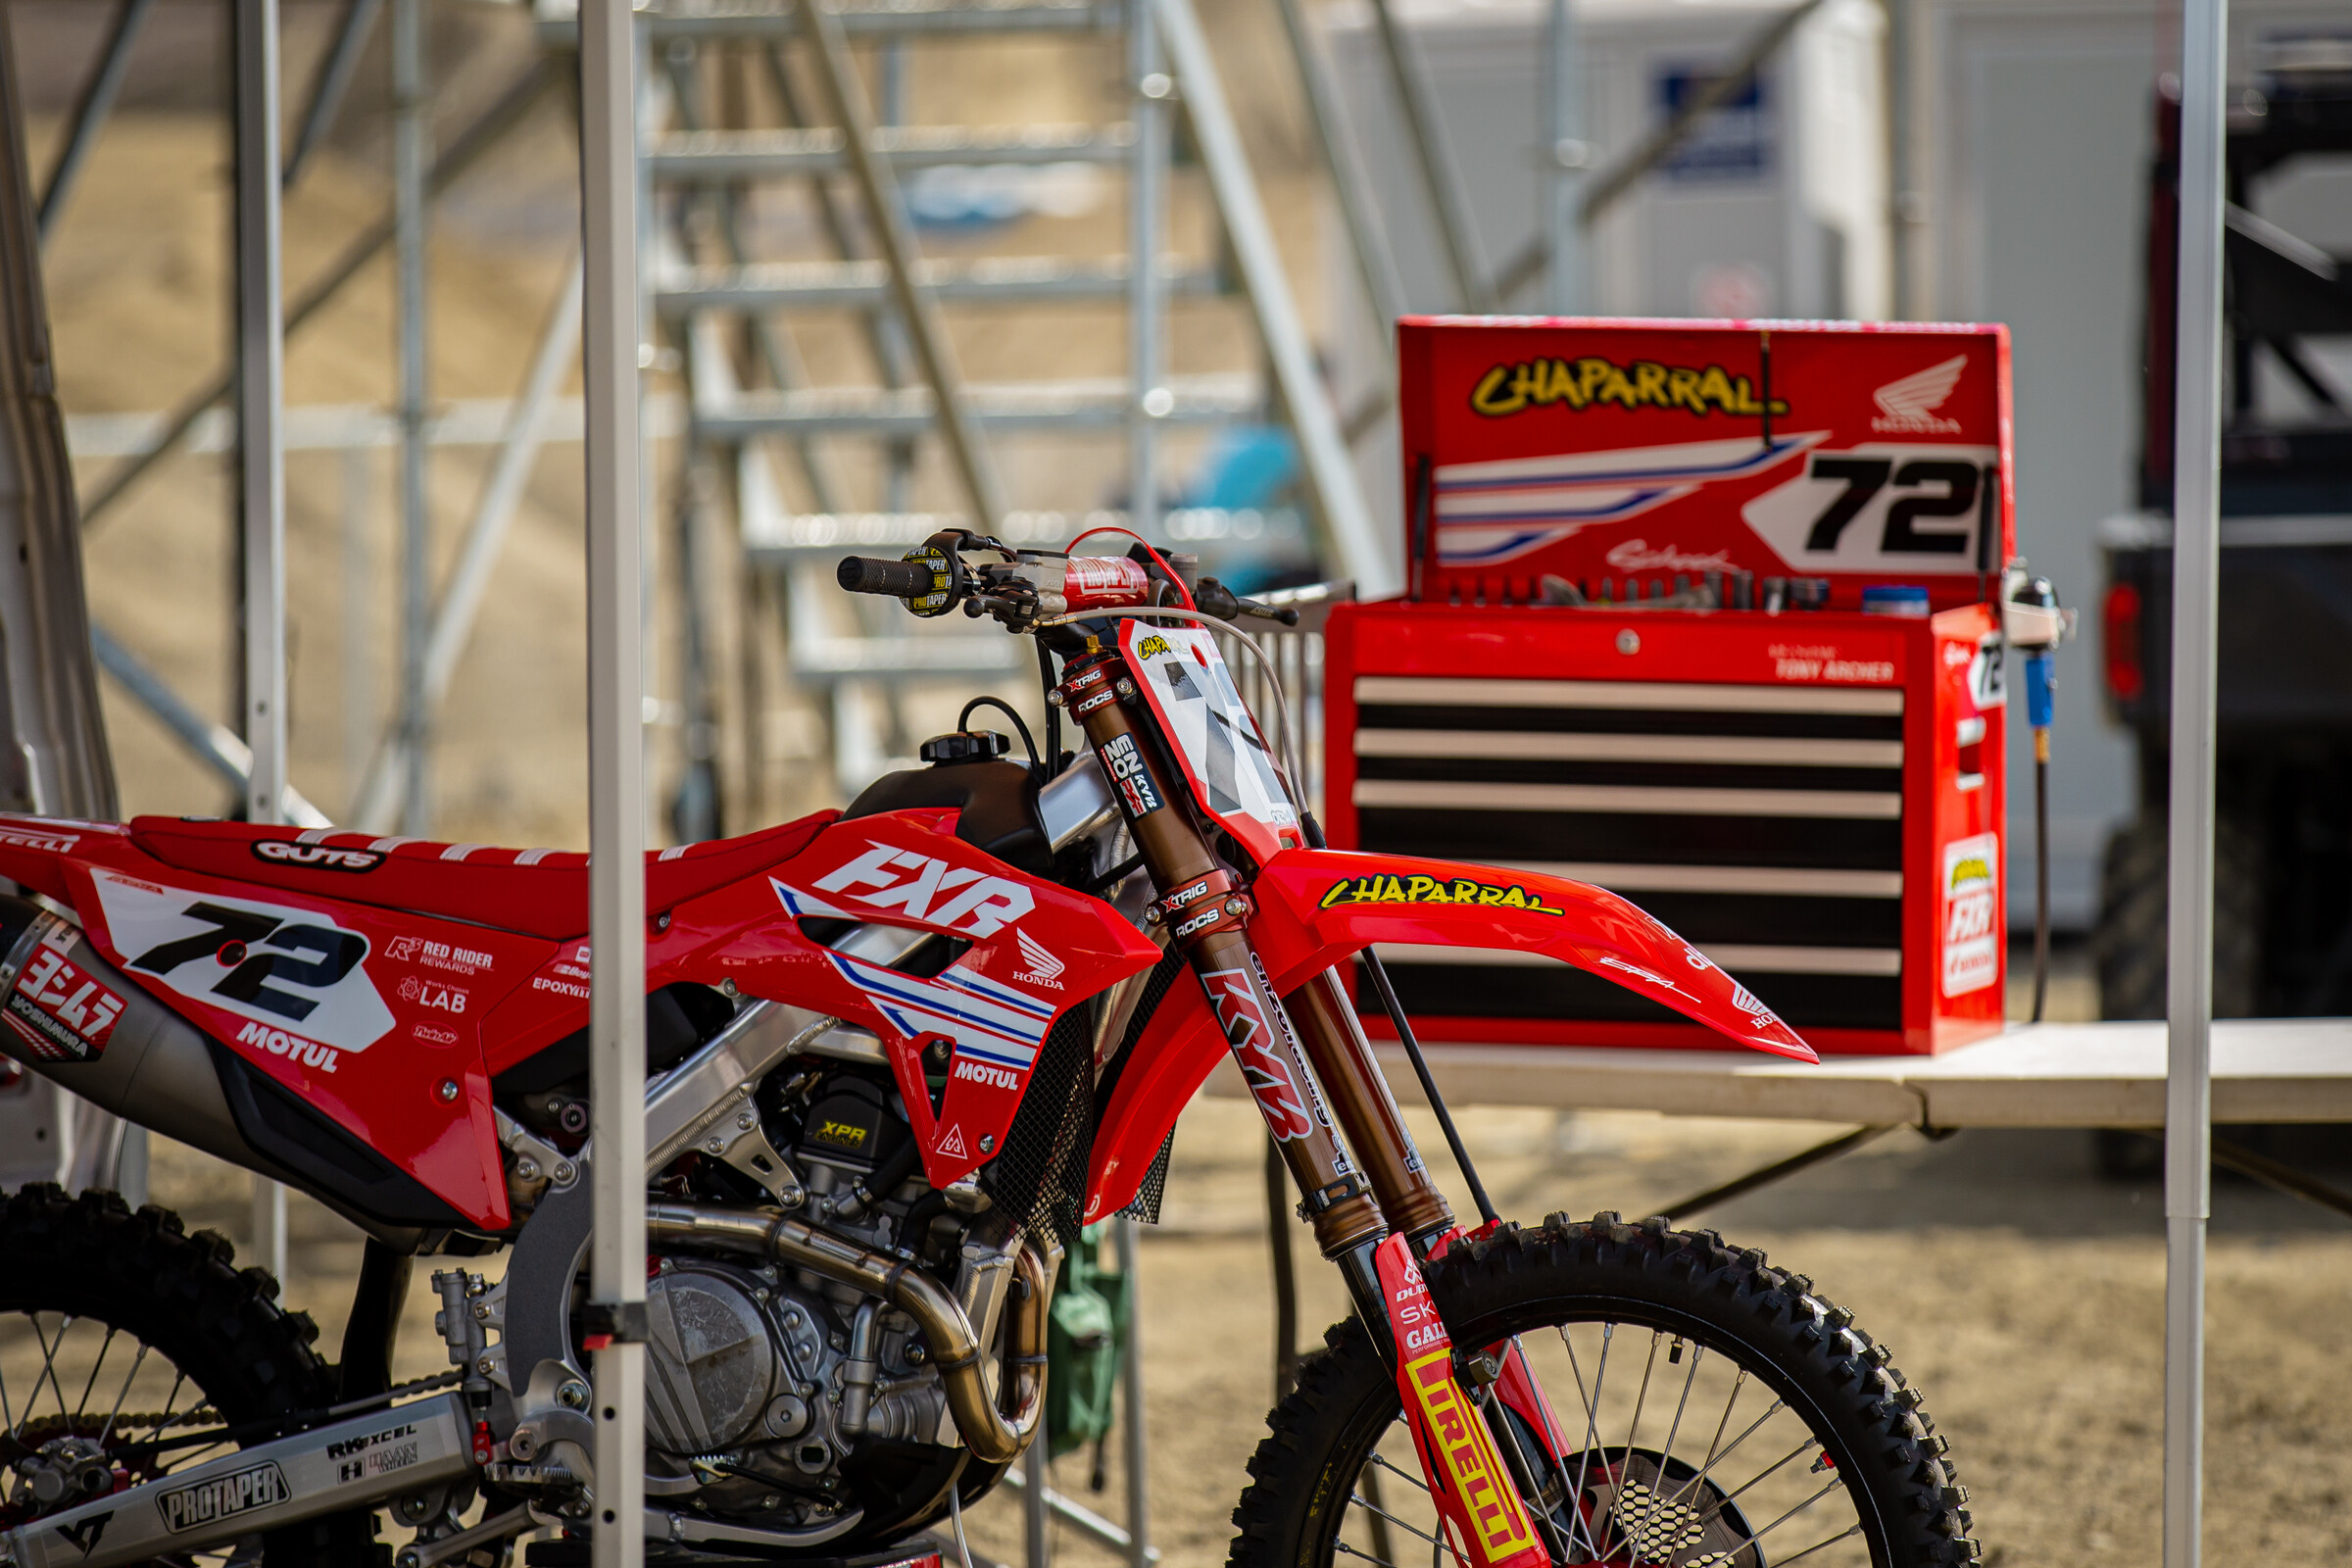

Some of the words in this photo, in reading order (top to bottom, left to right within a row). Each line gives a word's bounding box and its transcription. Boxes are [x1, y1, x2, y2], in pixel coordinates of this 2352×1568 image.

[1471, 359, 1789, 416] CHAPARRAL
[1805, 458, 1979, 554] 72
[1067, 669, 1102, 692] XTRIG
[1079, 689, 1113, 713] ROCS
[256, 841, 377, 868] GUTS
[810, 839, 1036, 939] FXR
[1163, 882, 1207, 912] XTRIG
[1319, 874, 1564, 916] CHAPARRAL
[1176, 908, 1220, 938] ROCS
[129, 901, 368, 1022] 72
[419, 955, 475, 976] REWARDS
[422, 940, 451, 958] RED
[452, 947, 494, 968] RIDER
[18, 950, 123, 1039] ヨシムラ
[418, 985, 466, 1014] LAB
[1012, 971, 1065, 992] HONDA
[11, 993, 88, 1058] YOSHIMURA
[236, 1022, 339, 1073] MOTUL
[1200, 968, 1313, 1143] KYB
[955, 1060, 1018, 1091] MOTUL
[1415, 1359, 1527, 1548] PIRELLI
[168, 1469, 281, 1526] PROTAPER
